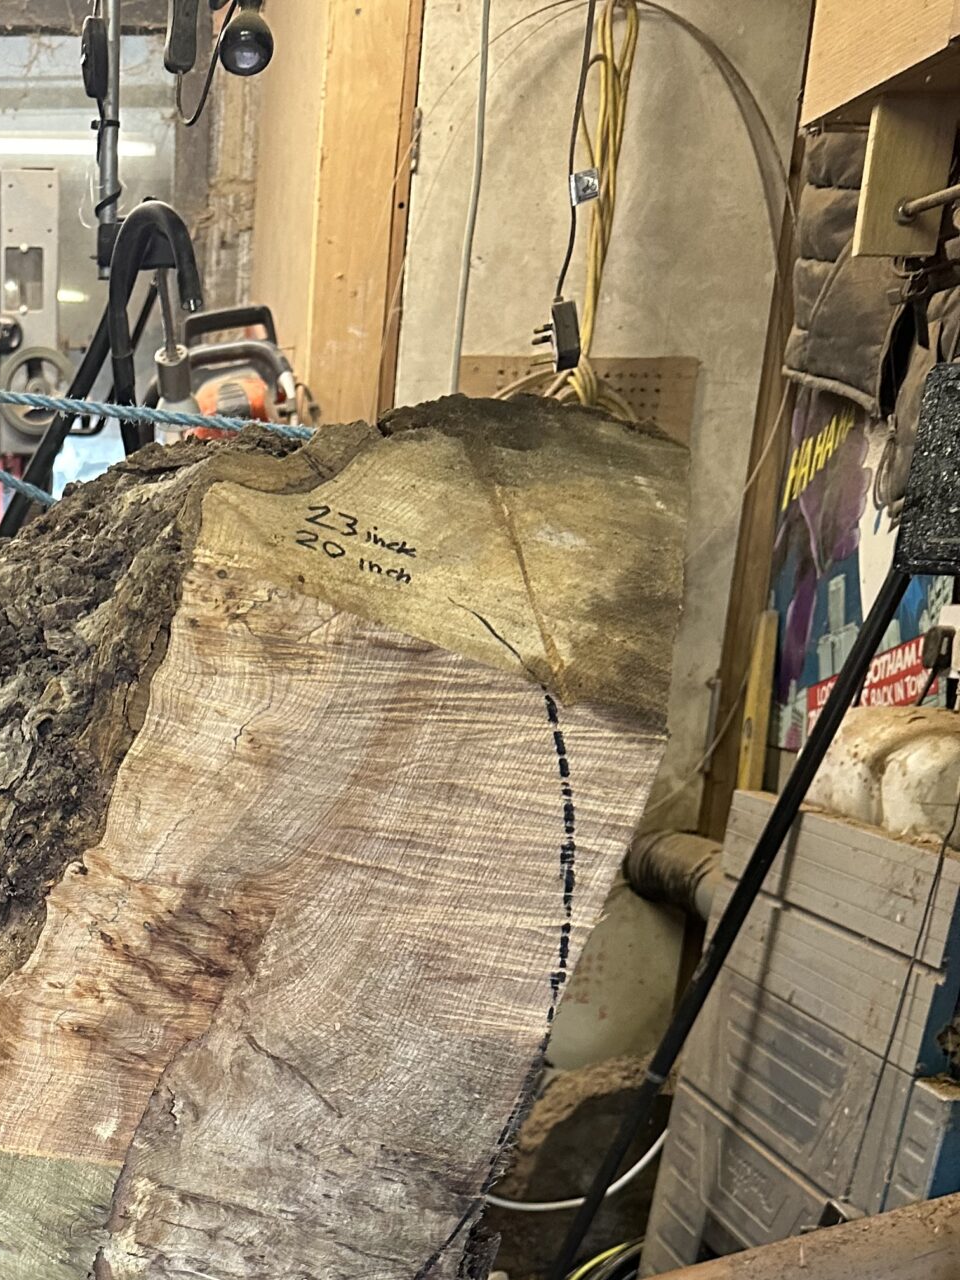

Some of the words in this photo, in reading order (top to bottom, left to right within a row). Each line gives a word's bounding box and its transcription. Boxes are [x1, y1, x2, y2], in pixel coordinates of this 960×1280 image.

[305, 505, 358, 536] 23
[296, 530, 346, 558] 20
[359, 557, 412, 584] inch
[870, 682, 894, 706] BACK
[894, 678, 905, 702] IN
